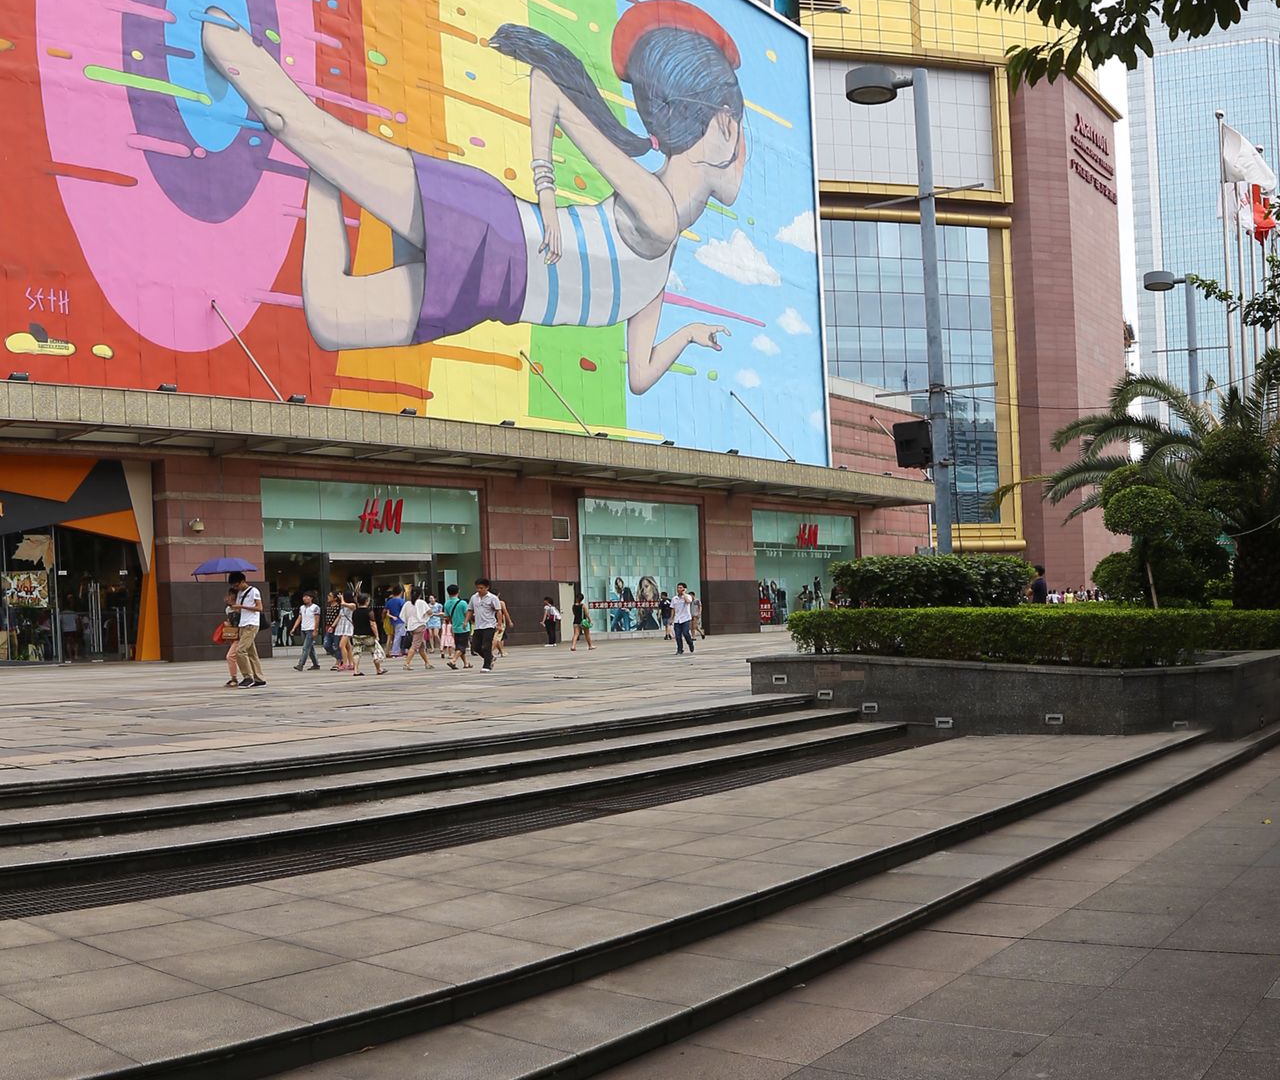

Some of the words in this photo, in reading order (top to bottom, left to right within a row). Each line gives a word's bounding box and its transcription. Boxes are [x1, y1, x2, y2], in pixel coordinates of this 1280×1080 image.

[25, 286, 70, 315] SETH
[358, 497, 404, 534] H&M
[796, 522, 819, 550] H&M
